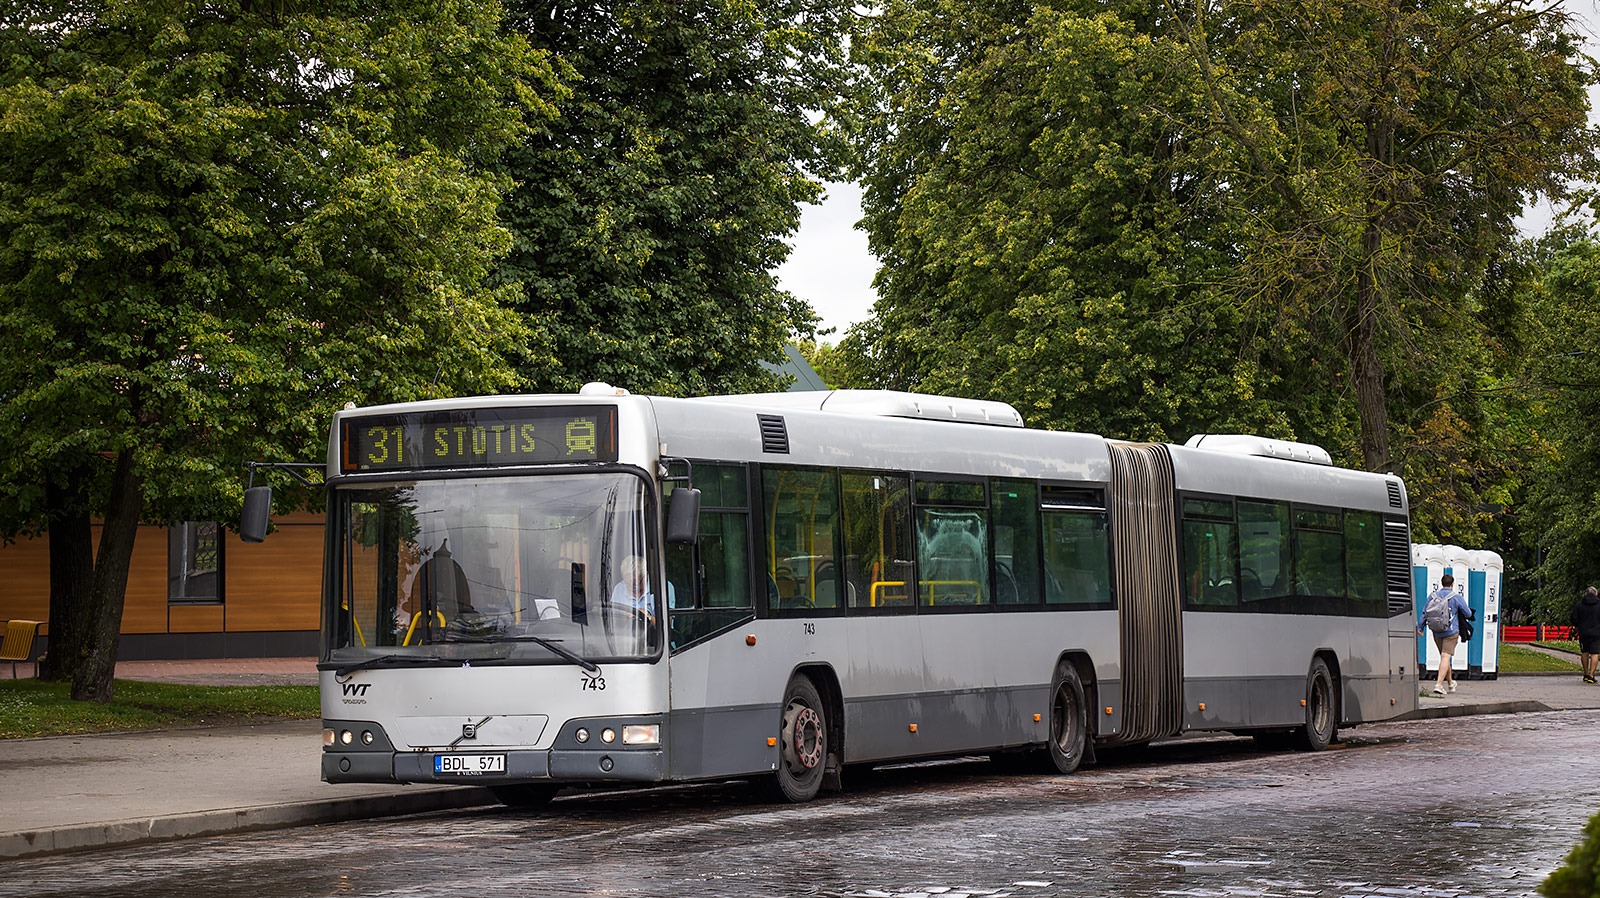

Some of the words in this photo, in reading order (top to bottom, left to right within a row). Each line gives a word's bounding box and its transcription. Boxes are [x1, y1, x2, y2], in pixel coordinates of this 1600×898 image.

[368, 425, 403, 463] 31
[434, 423, 535, 456] STOTIS
[803, 622, 816, 635] 743
[342, 683, 372, 696] VVT
[580, 677, 607, 691] 743
[443, 757, 470, 770] BDL
[479, 756, 501, 770] 571
